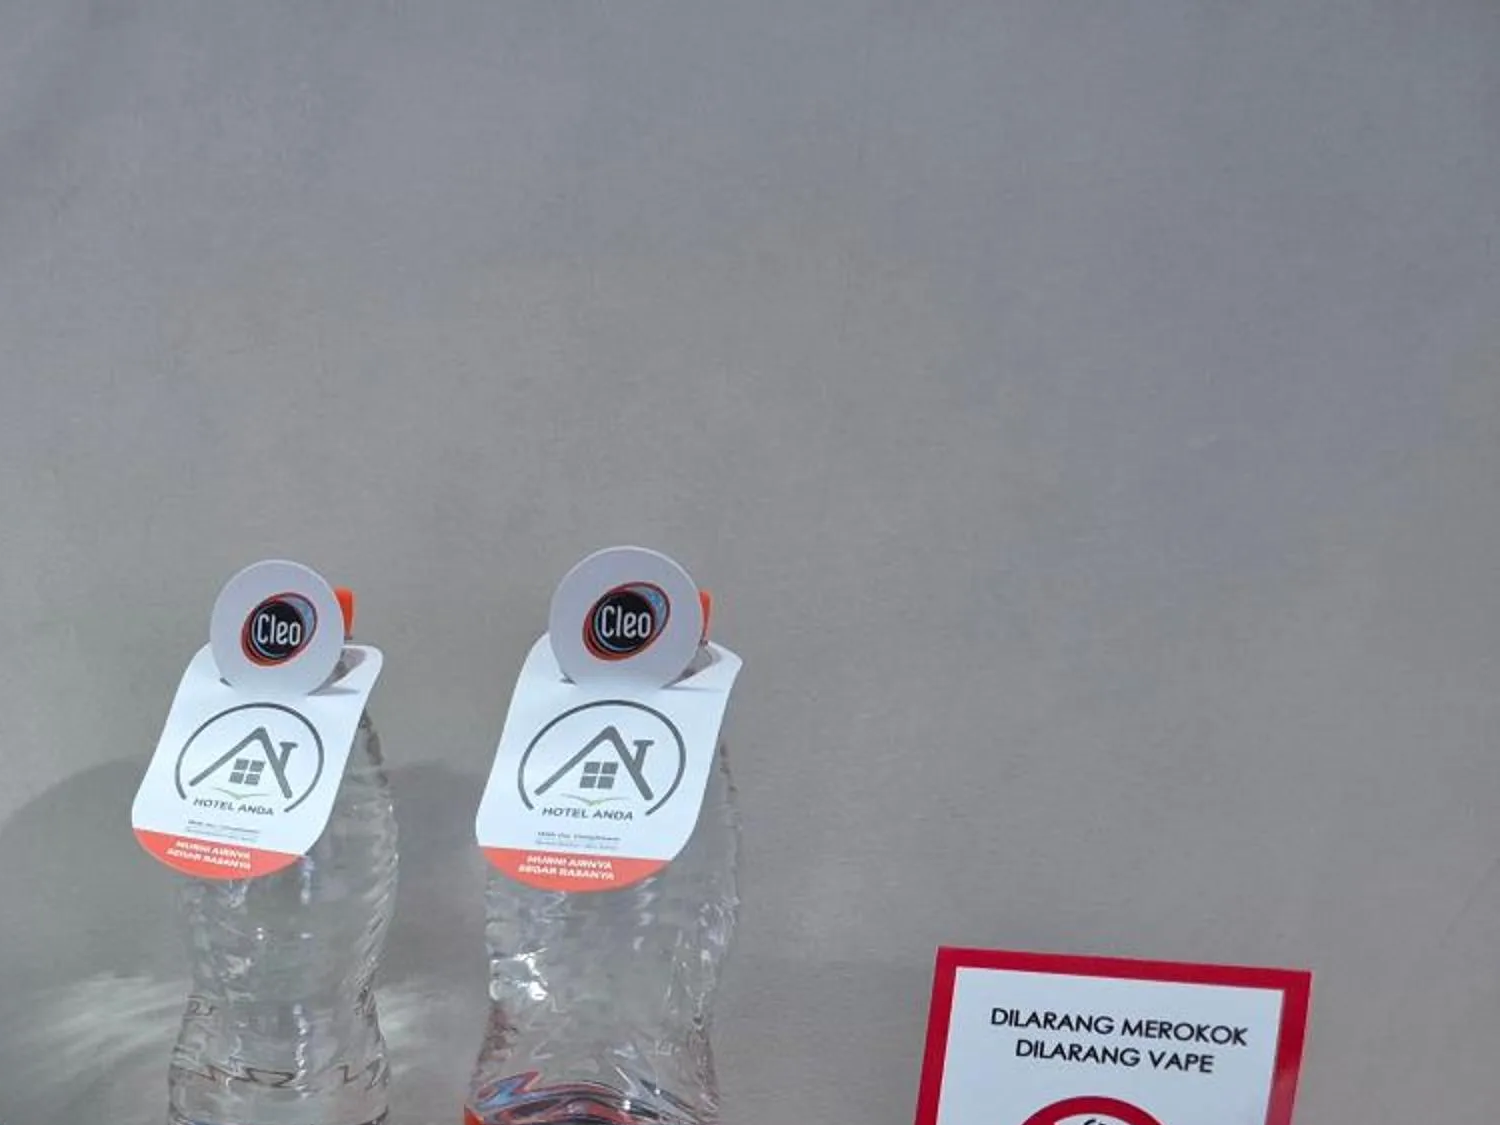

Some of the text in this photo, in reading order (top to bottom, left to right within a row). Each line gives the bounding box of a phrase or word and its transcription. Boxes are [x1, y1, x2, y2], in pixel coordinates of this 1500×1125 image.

[256, 613, 301, 646] Cleo
[600, 605, 651, 639] Cleo
[193, 798, 275, 816] HOTEL ANDA
[542, 807, 633, 821] HOTEL ANDA
[991, 1007, 1248, 1046] DILARANG MEROKOK
[1015, 1039, 1215, 1074] DILARANG VAPE
